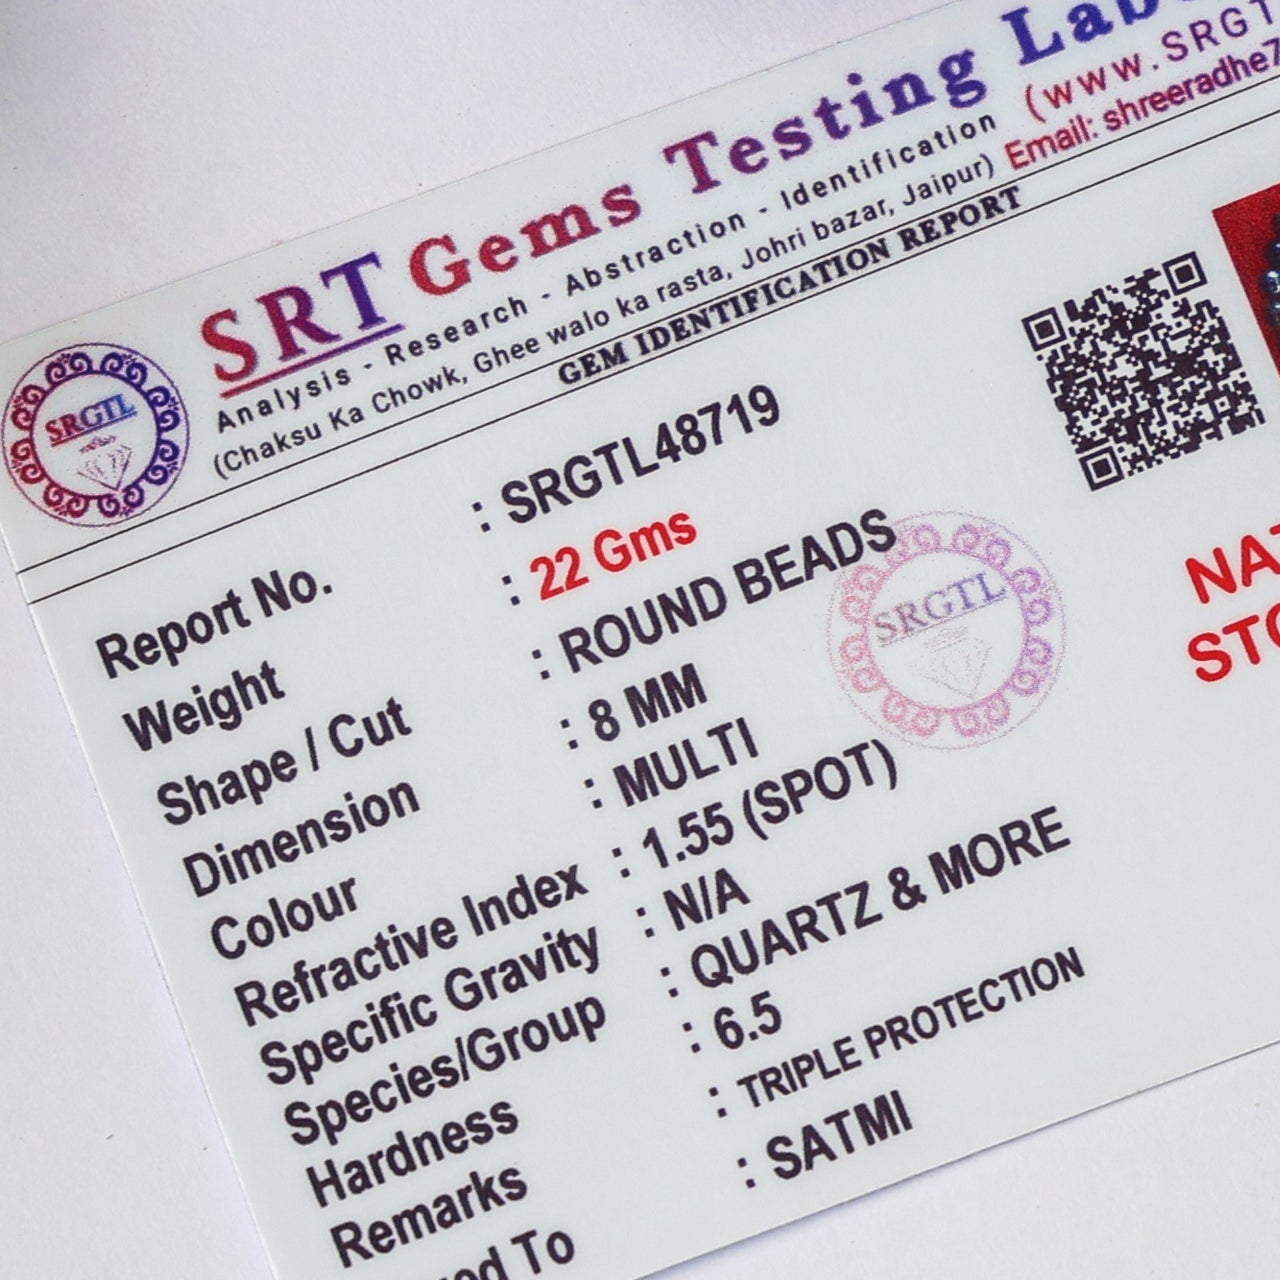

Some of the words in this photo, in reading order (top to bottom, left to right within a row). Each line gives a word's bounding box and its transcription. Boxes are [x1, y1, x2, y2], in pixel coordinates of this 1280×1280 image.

[200, 251, 387, 383] SRT
[408, 183, 642, 297] Gems
[661, 48, 988, 195] Testing
[1004, 114, 1099, 171] Email:
[213, 422, 322, 481] (Chaksu
[328, 406, 365, 431] Ka
[371, 366, 468, 414] Chowk,
[473, 337, 541, 374] Ghee
[545, 310, 610, 345] walo
[615, 294, 650, 318] ka
[656, 265, 733, 303] rasta,
[741, 227, 807, 270] Johri
[810, 198, 895, 241] bazar,
[902, 153, 994, 207] Jaipur)
[217, 368, 351, 434] Analysis
[384, 296, 528, 366] Research
[566, 213, 746, 297] Abstraction
[780, 114, 997, 211] Identification
[555, 341, 630, 385] GEM
[634, 240, 891, 354] IDENTIFICATION
[898, 185, 1023, 250] REPORT
[44, 393, 137, 443] SRGTL
[95, 588, 252, 680] Report
[250, 569, 333, 618] No.
[501, 384, 780, 524] SRGTL48719
[121, 660, 286, 752] Weight
[529, 546, 590, 601] 22
[593, 512, 697, 573] Gms
[156, 749, 298, 826] Shape
[327, 696, 413, 758] Cut
[557, 576, 728, 674] ROUND
[732, 508, 898, 605] BEADS
[870, 570, 1007, 642] SRGTL
[182, 781, 421, 898] Dimension
[587, 698, 621, 742] 8
[623, 662, 708, 728] MM
[210, 877, 357, 960] Colour
[612, 717, 759, 808] MULTI
[233, 916, 459, 1028] Refractive
[461, 863, 590, 937] Index
[642, 801, 734, 869] 1.55
[742, 739, 898, 841] (SPOT)
[259, 991, 438, 1086] Specific
[444, 926, 599, 1012] Gravity
[662, 867, 751, 932] N/A
[284, 996, 606, 1146] Species/Group
[690, 880, 884, 989] QUARTZ
[887, 866, 928, 911] &
[927, 805, 1071, 895] MORE
[305, 1100, 519, 1209] Hardness
[713, 990, 783, 1050] 6.5
[329, 1167, 528, 1269] Remarks
[736, 1035, 863, 1108] TRIPLE
[862, 946, 1085, 1060] PROTECTION
[514, 1229, 575, 1275] To
[766, 1089, 913, 1180] SATMI
